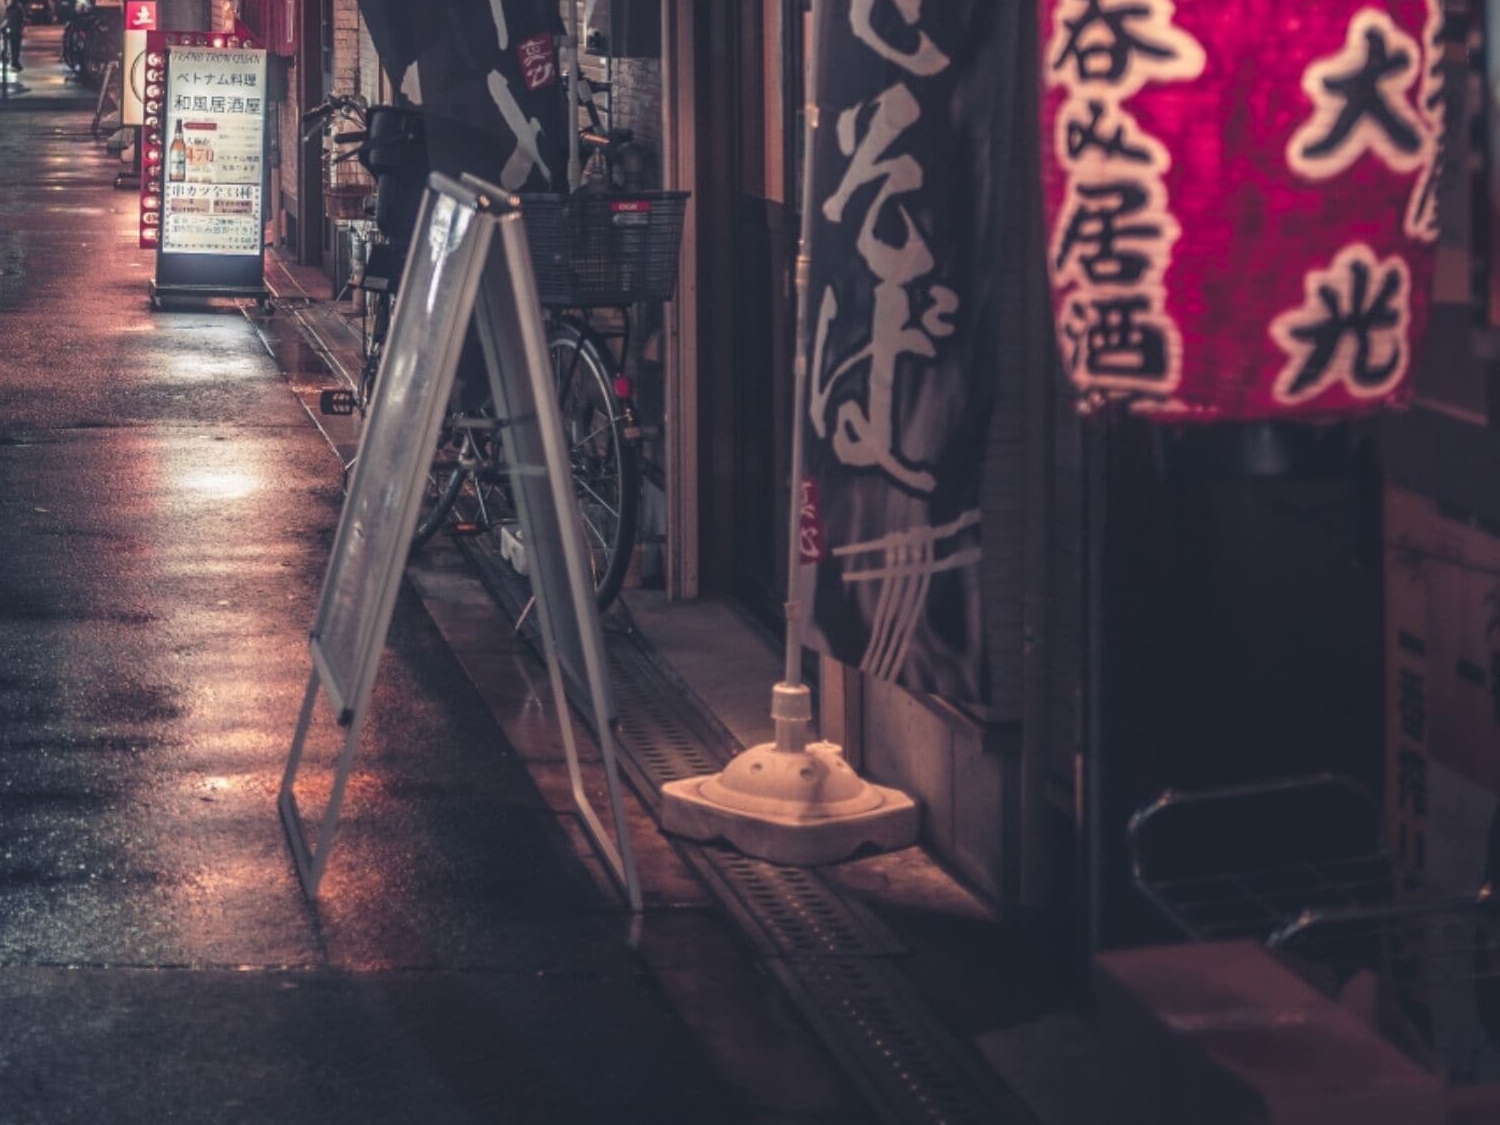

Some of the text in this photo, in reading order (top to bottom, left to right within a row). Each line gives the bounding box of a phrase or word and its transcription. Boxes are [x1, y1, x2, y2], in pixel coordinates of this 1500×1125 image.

[176, 72, 257, 86] ベトナム料理
[174, 94, 261, 115] 和風居酒屋
